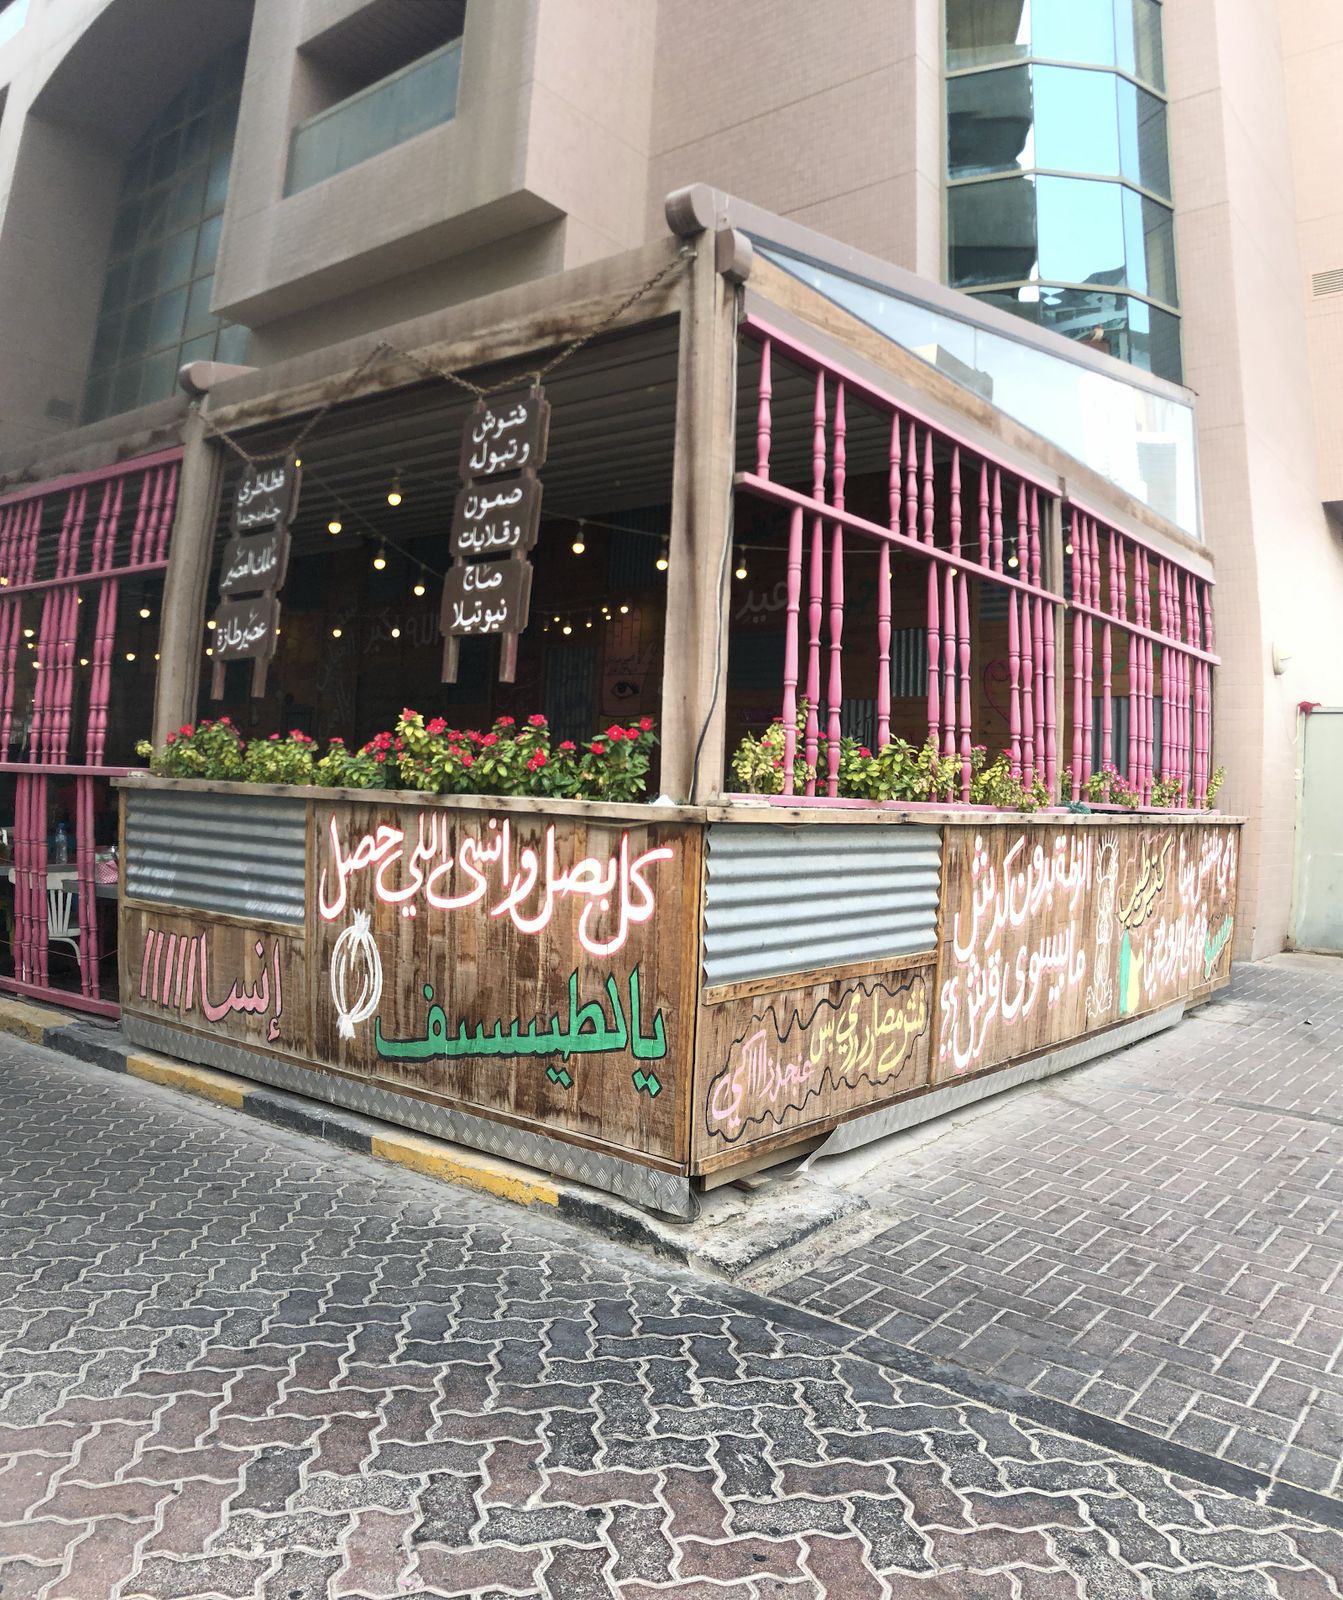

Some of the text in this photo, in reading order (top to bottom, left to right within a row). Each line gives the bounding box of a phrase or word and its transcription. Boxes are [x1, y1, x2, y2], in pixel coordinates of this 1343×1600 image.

[472, 405, 528, 442] فتوش
[464, 488, 523, 520] صمون
[458, 520, 521, 551] وقلايات
[463, 565, 502, 591] صاج
[451, 599, 508, 632] نيوتيلا
[319, 811, 405, 921] حصل
[376, 811, 448, 918] اللي
[509, 824, 617, 934] بصل
[578, 831, 674, 957] كل
[953, 834, 1026, 963] كرش
[810, 1016, 835, 1064] بس
